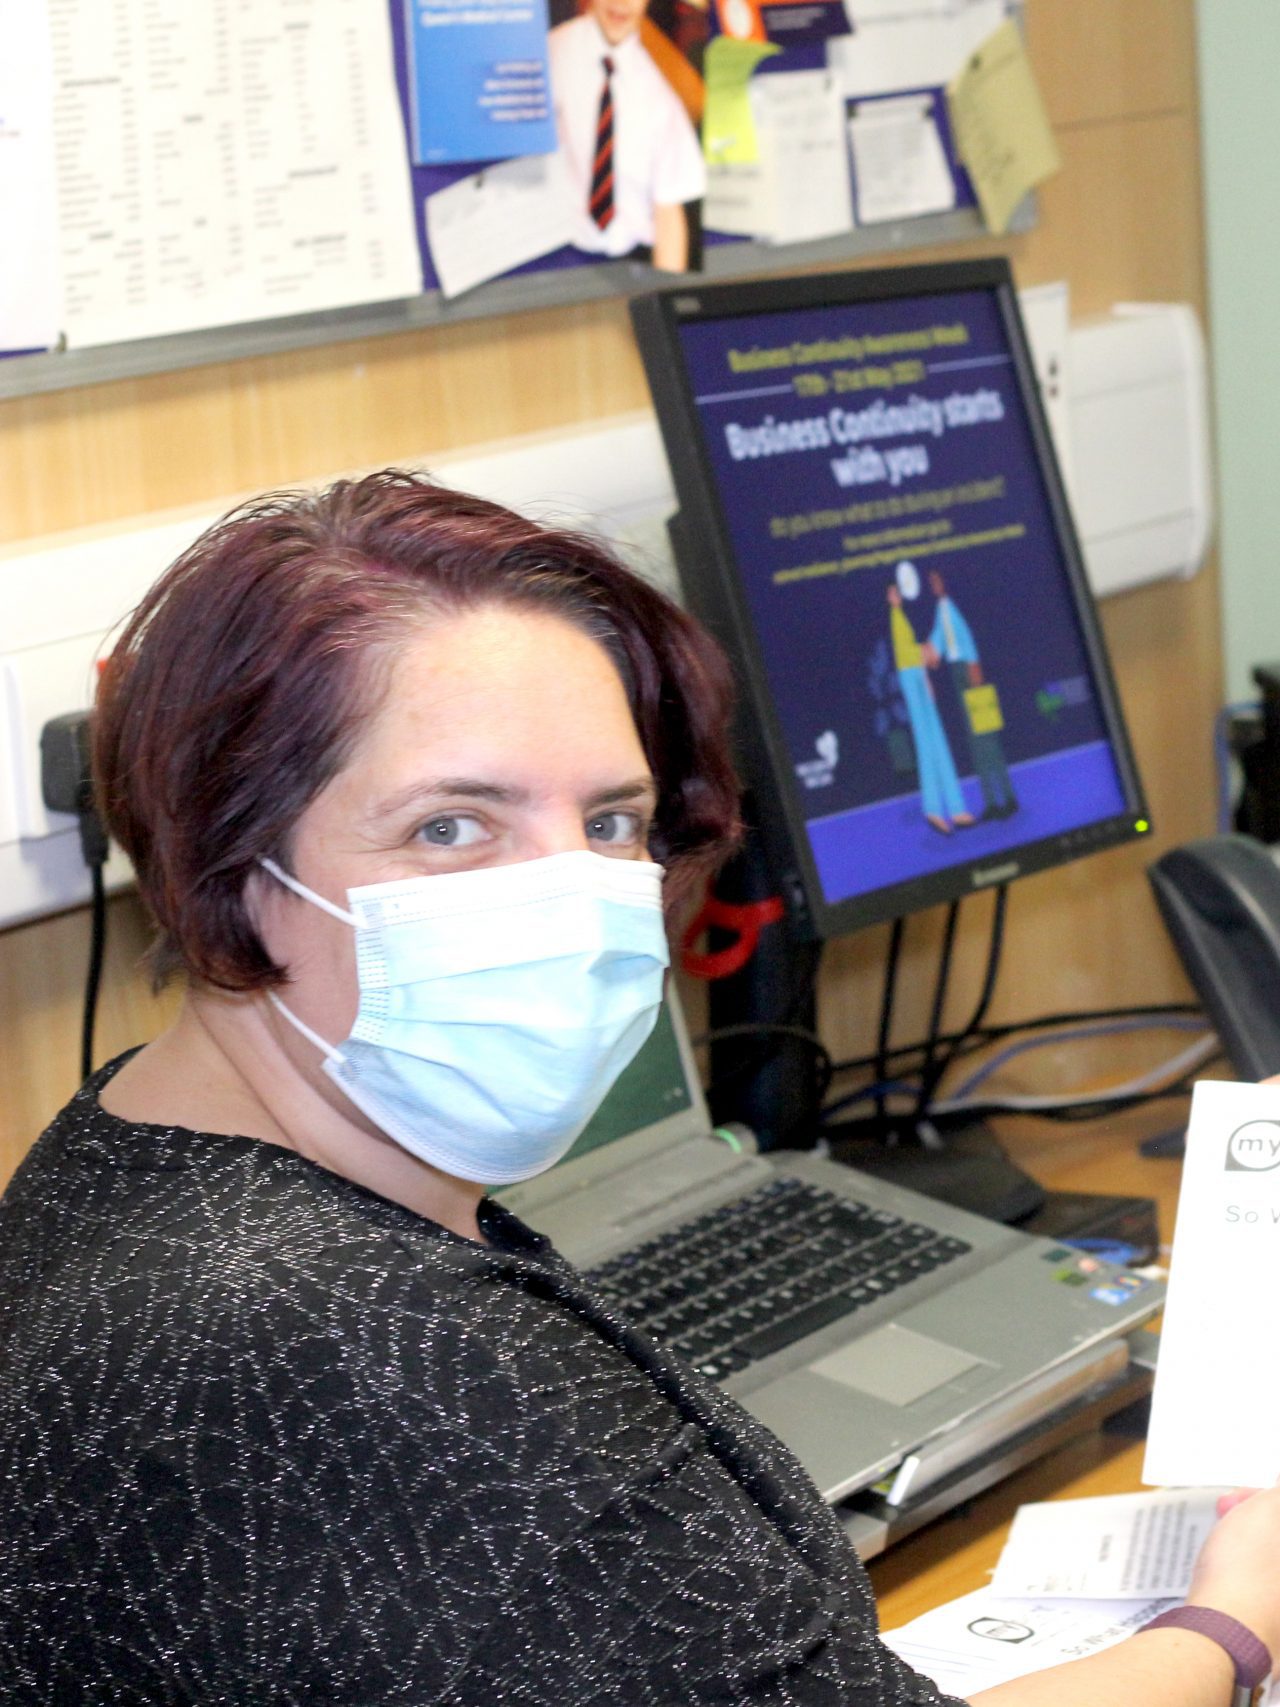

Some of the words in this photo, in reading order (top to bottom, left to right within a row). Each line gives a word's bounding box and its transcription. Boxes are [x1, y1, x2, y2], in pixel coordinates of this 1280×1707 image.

[725, 414, 831, 460] Business
[829, 394, 944, 444] Continuity
[943, 388, 1004, 427] starts
[830, 445, 887, 487] with
[885, 444, 928, 486] you
[1225, 1205, 1259, 1223] So
